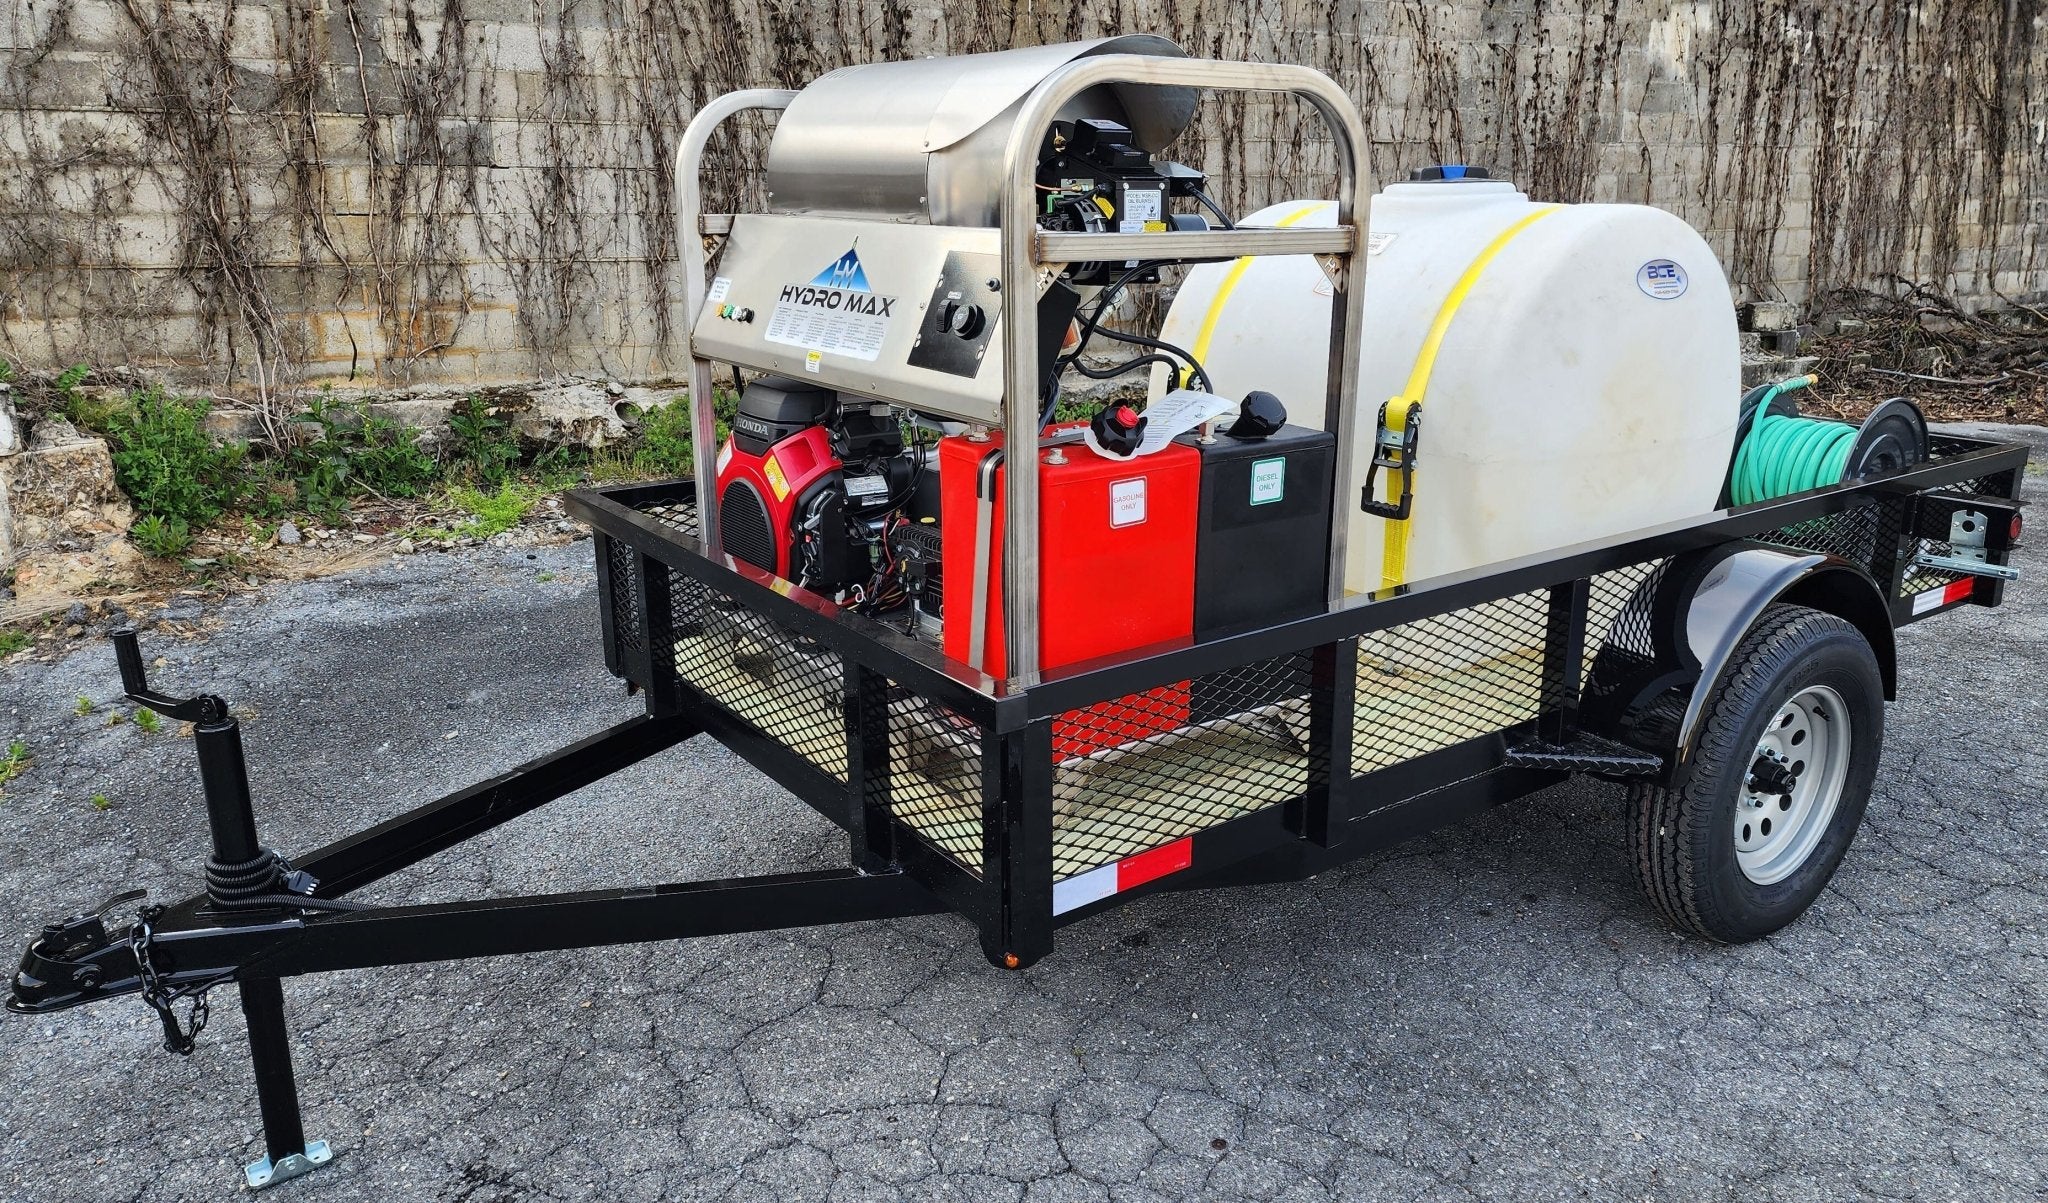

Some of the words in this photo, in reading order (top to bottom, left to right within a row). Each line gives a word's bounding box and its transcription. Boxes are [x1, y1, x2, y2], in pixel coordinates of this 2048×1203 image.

[779, 284, 842, 310] HYDRO
[844, 293, 897, 318] MAX
[736, 416, 769, 436] HONDA
[1256, 472, 1278, 483] DIESEL
[1258, 482, 1276, 491] ONLY
[1113, 491, 1144, 504] GASOLINE
[1121, 502, 1137, 511] ONLY
